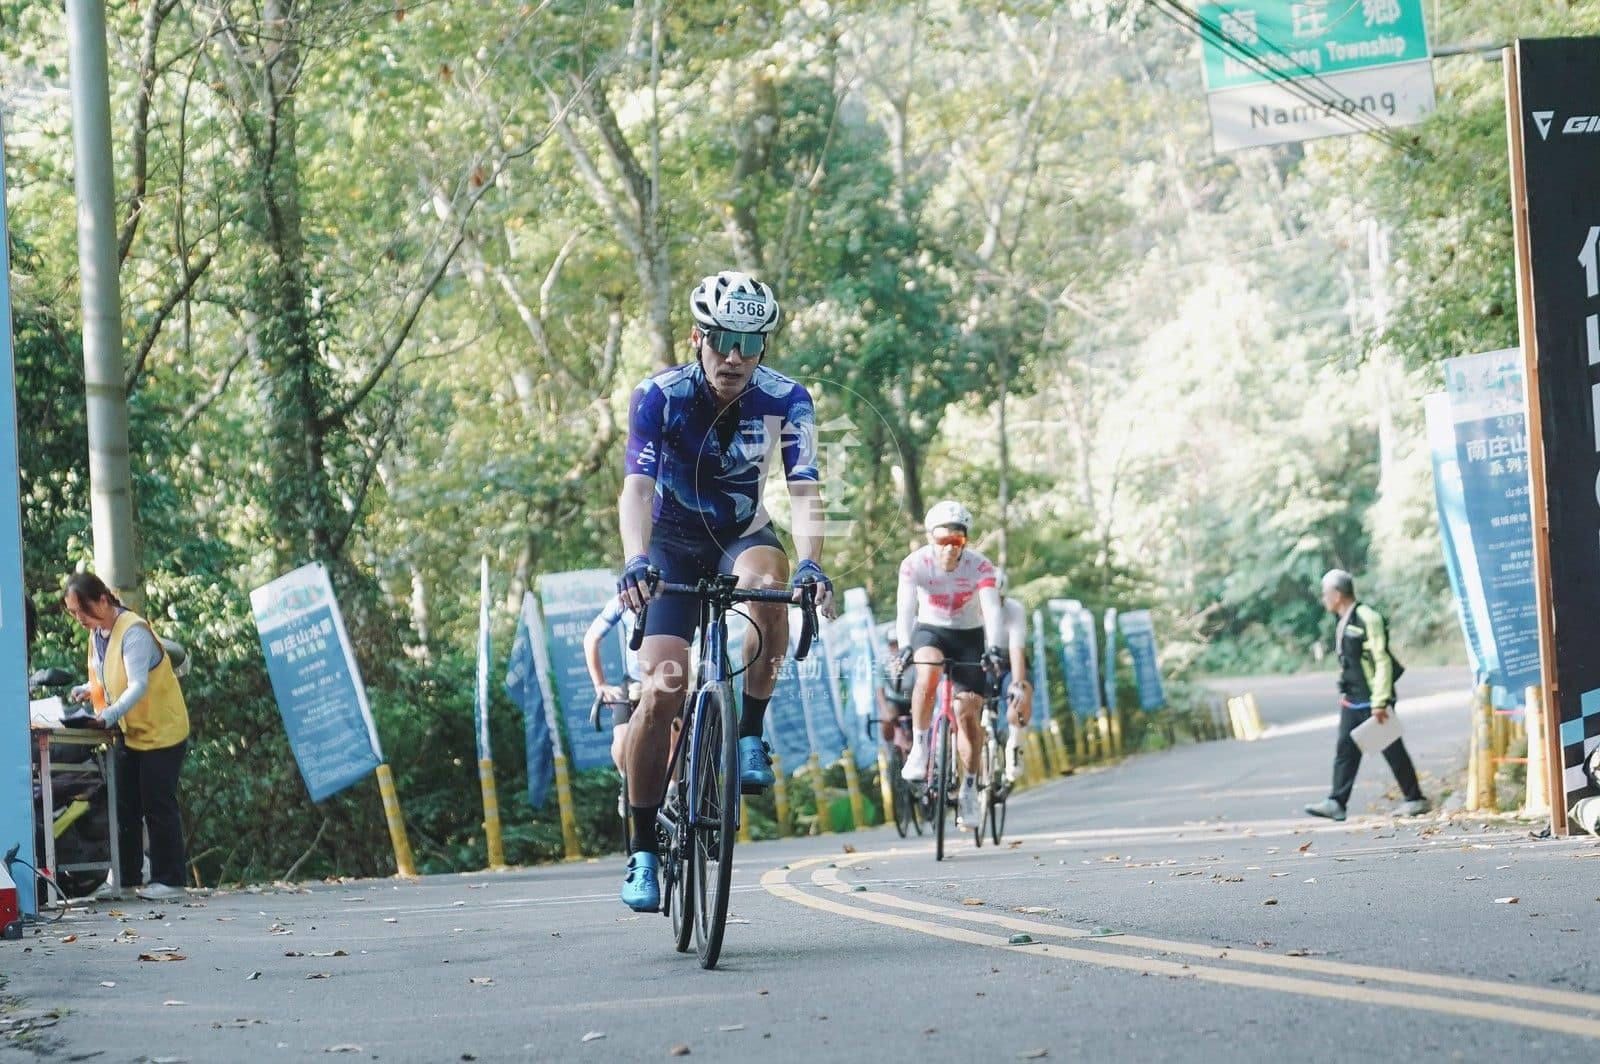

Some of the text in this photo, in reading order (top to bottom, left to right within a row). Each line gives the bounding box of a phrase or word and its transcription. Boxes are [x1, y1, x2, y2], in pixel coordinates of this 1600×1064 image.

[1324, 33, 1406, 62] Township
[1250, 91, 1397, 129] Namzong
[1562, 115, 1600, 133] GI
[724, 301, 765, 317] 1368
[1497, 414, 1524, 429] 202
[1465, 431, 1528, 464] 南庄山
[1490, 455, 1529, 476] 系列
